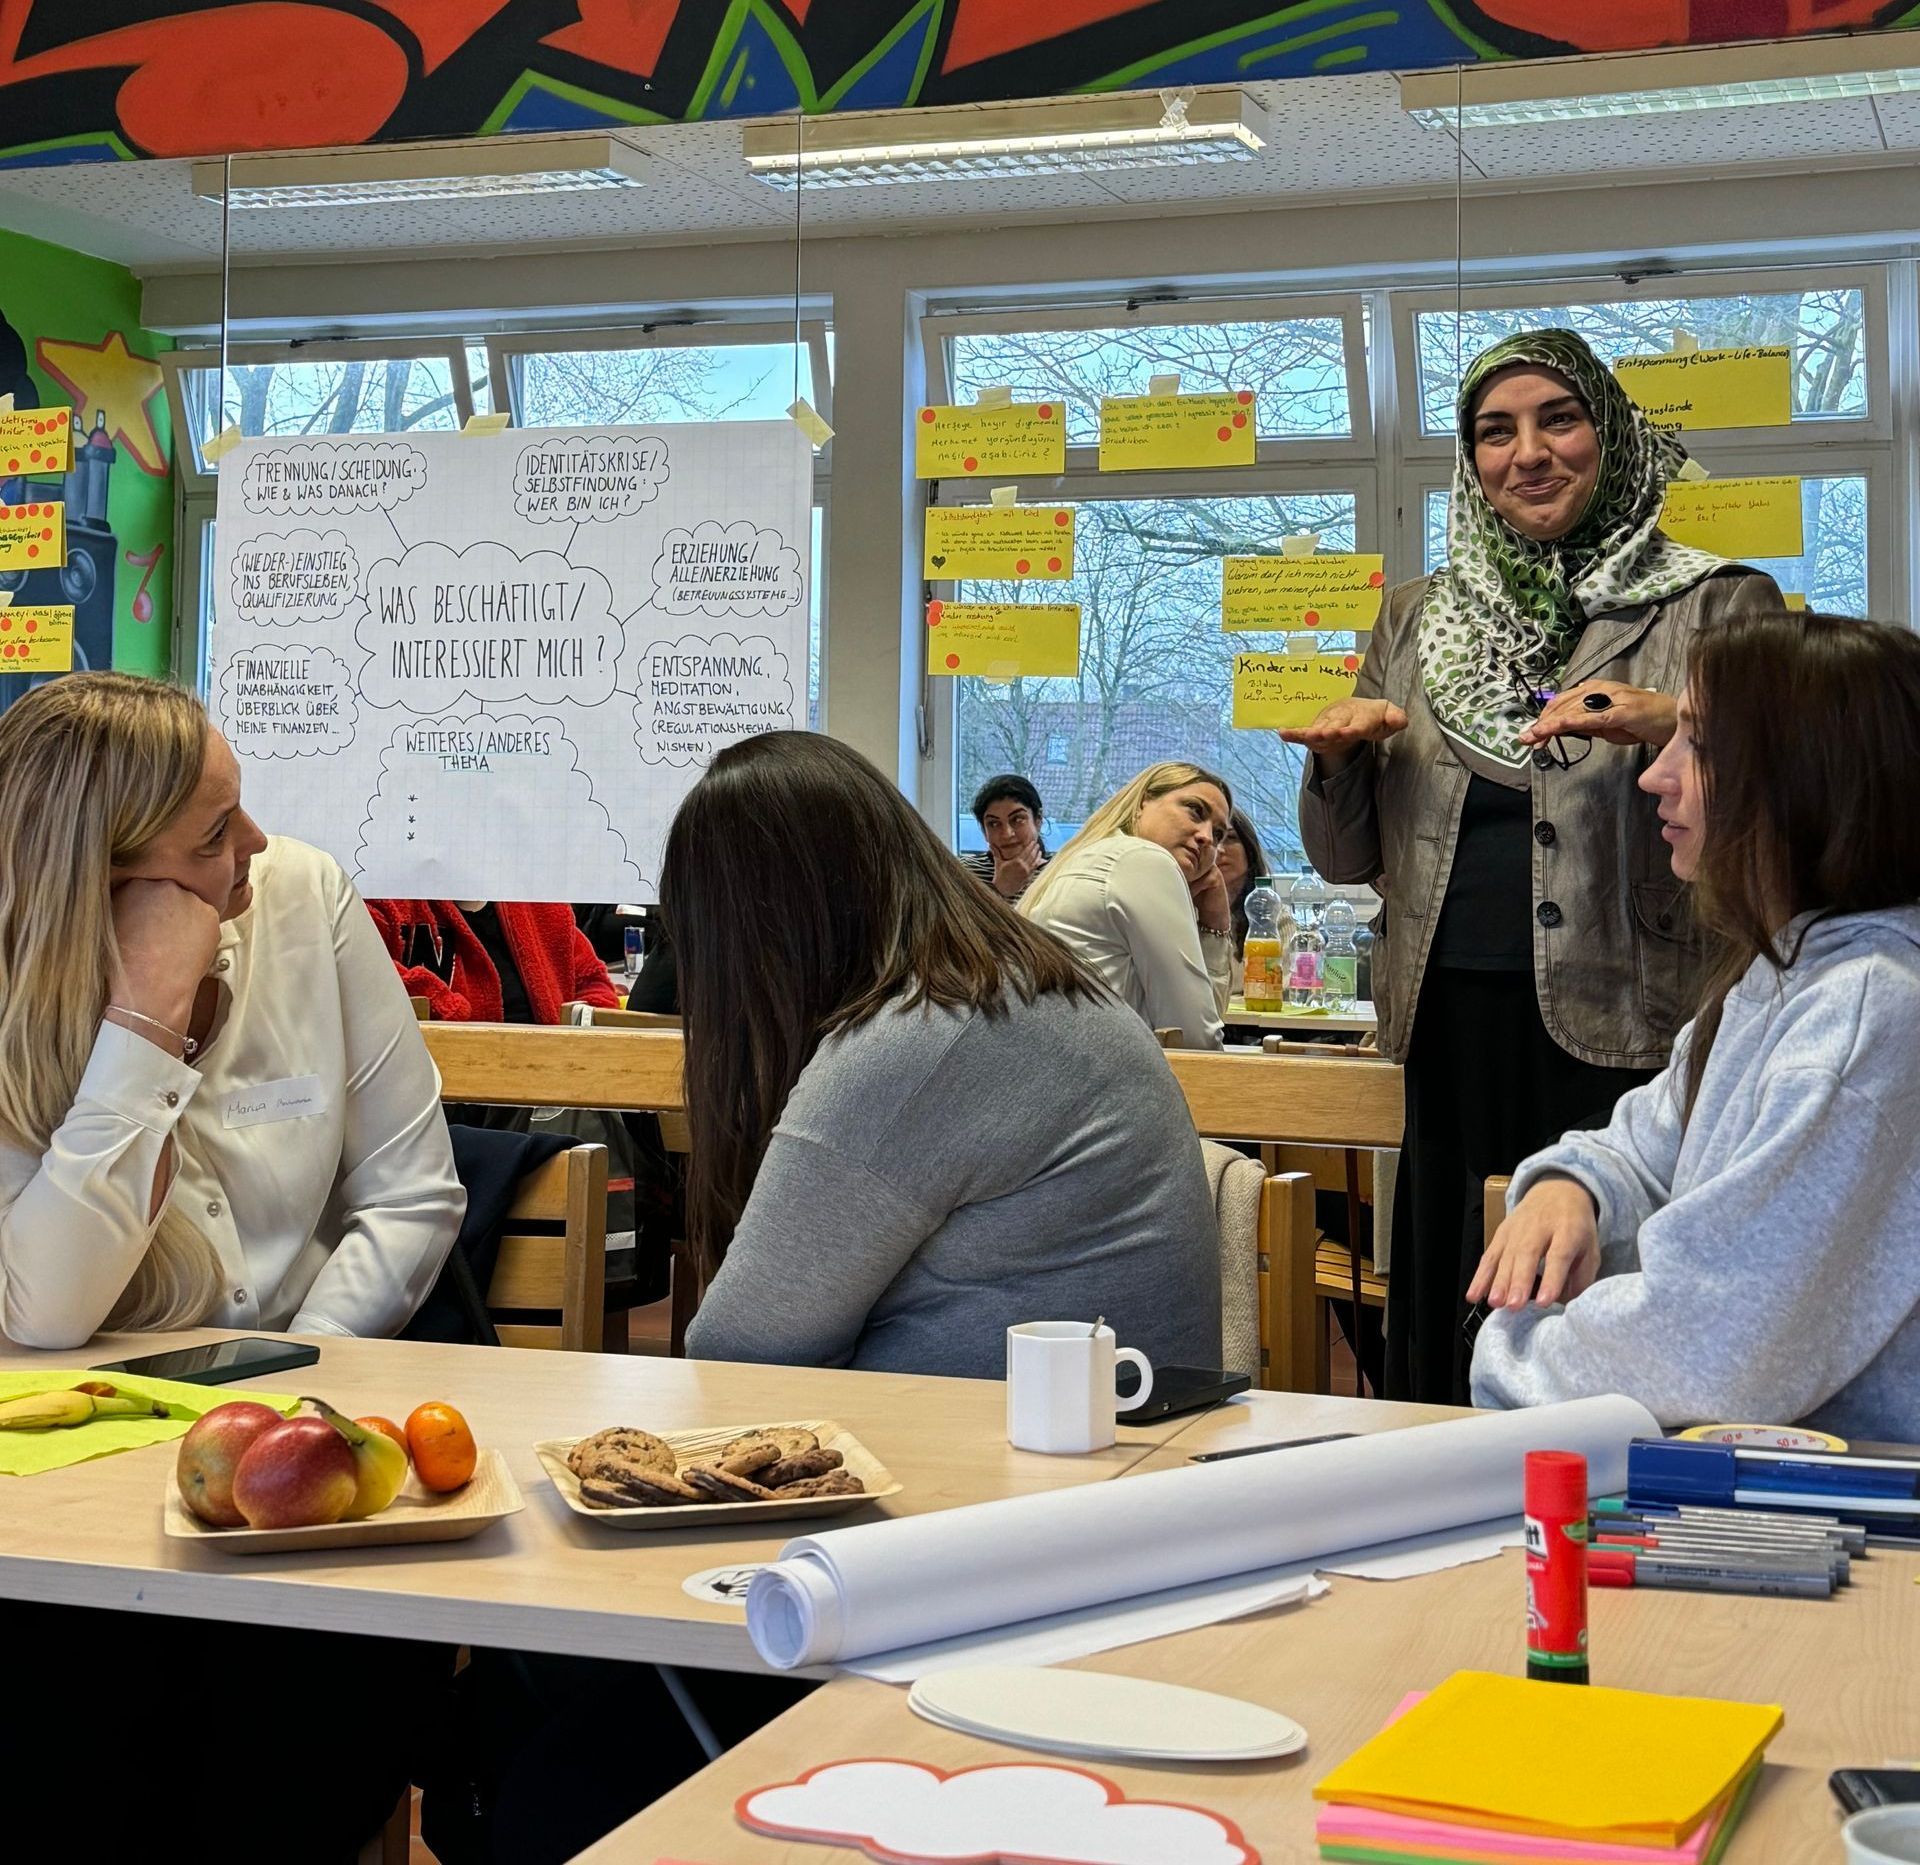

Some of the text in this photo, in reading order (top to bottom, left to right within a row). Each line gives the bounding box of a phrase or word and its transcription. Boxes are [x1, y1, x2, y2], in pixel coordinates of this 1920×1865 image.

[258, 486, 278, 500] WIE
[283, 489, 290, 500] &
[298, 484, 322, 498] WAS
[527, 497, 557, 511] WER
[567, 497, 591, 511] BIN
[243, 575, 260, 590] INS
[670, 566, 779, 583] ALLEINERZIEHUNG
[243, 592, 337, 608] QUALIFIZIERUNG
[380, 586, 417, 624] WAS
[393, 639, 527, 679] INTERESSIERT
[1239, 657, 1284, 674] Kinder
[1290, 664, 1308, 672] und
[237, 660, 310, 680] FINANZIELLE
[236, 700, 339, 716] ÜBERBLICK ÜBER
[654, 701, 784, 715] ANGSTBEWÄLTIGUNG
[236, 722, 268, 734] MEINE
[439, 754, 490, 771] THEMA
